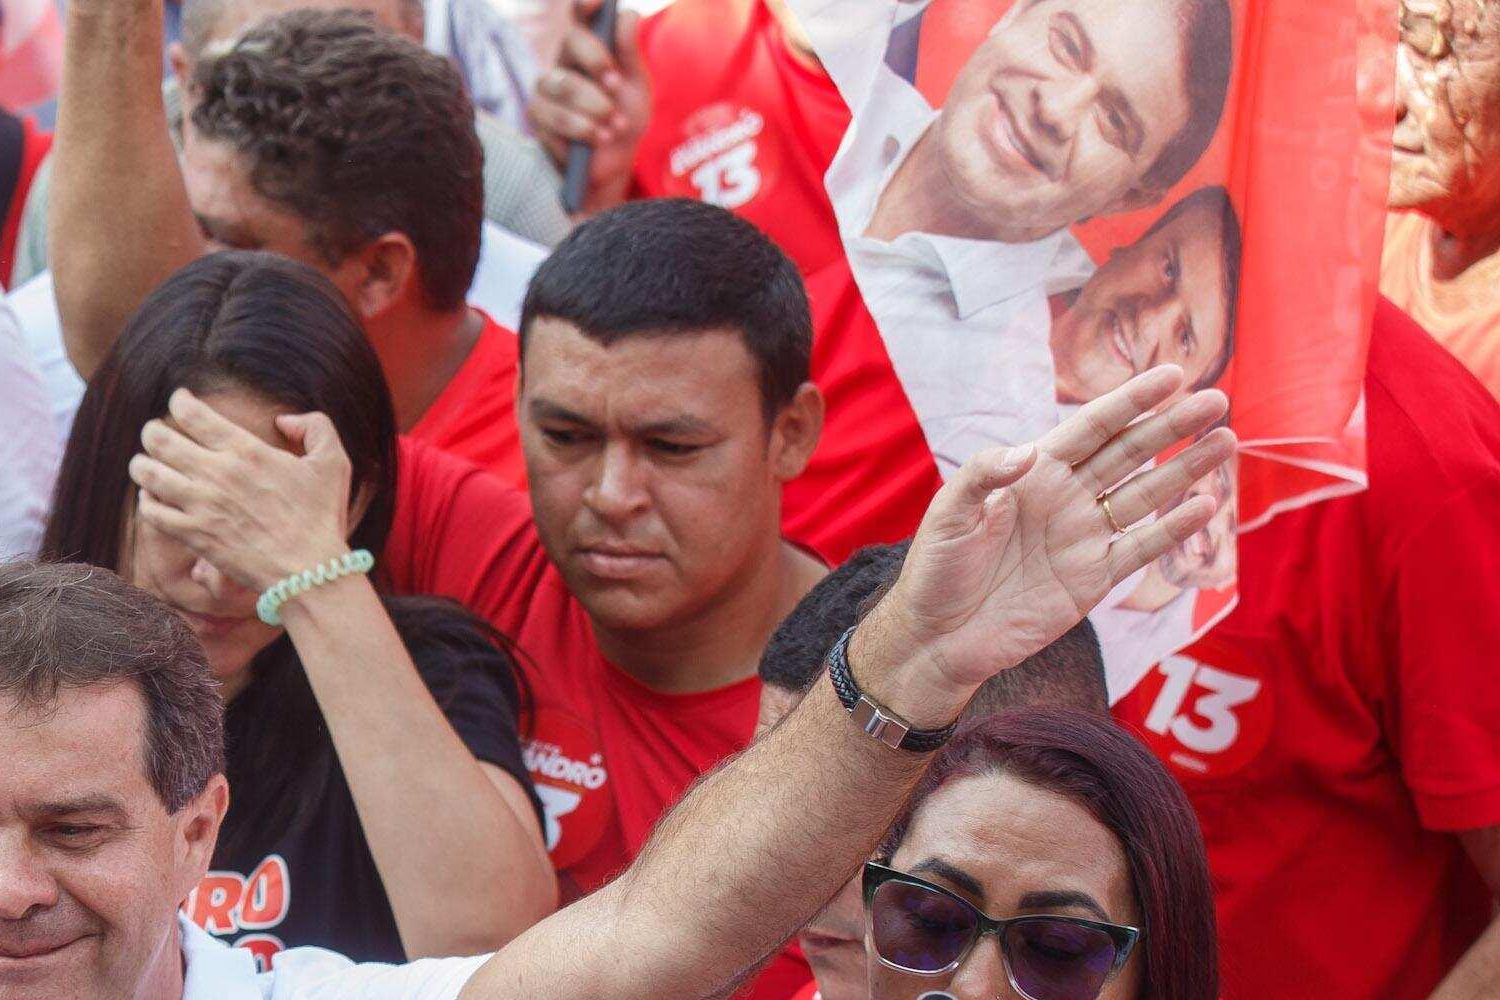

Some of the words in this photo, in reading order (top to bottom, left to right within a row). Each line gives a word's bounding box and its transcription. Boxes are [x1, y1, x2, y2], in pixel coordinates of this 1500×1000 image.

[691, 141, 761, 210] 13
[1144, 655, 1262, 755] 13
[179, 853, 291, 936] RO
